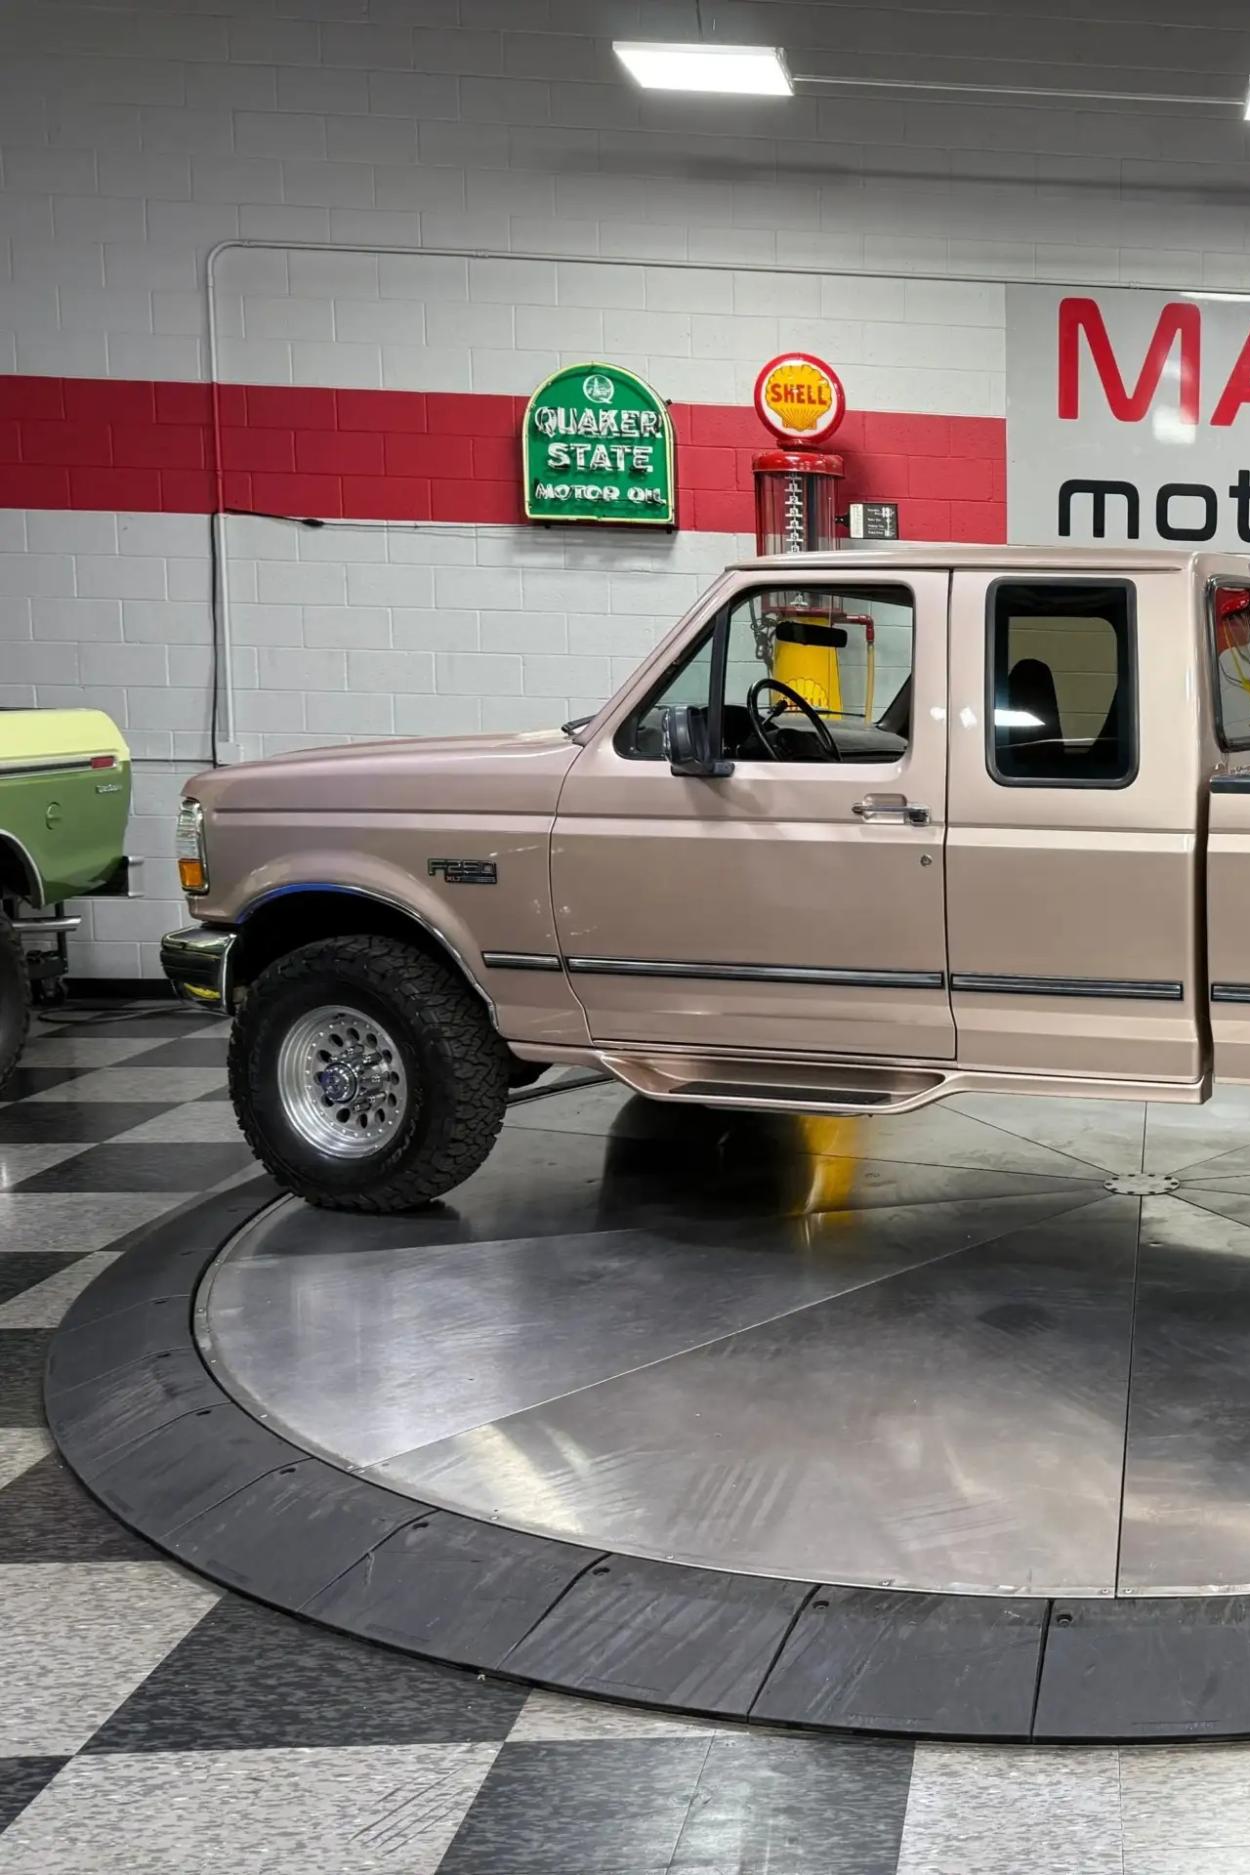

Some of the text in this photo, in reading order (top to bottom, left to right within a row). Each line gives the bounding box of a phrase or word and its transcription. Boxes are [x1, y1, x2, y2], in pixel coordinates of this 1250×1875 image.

[769, 382, 828, 406] SHELL
[534, 406, 663, 438] QUAKER
[547, 442, 654, 473] STATE
[535, 483, 667, 505] MOTOR OIL
